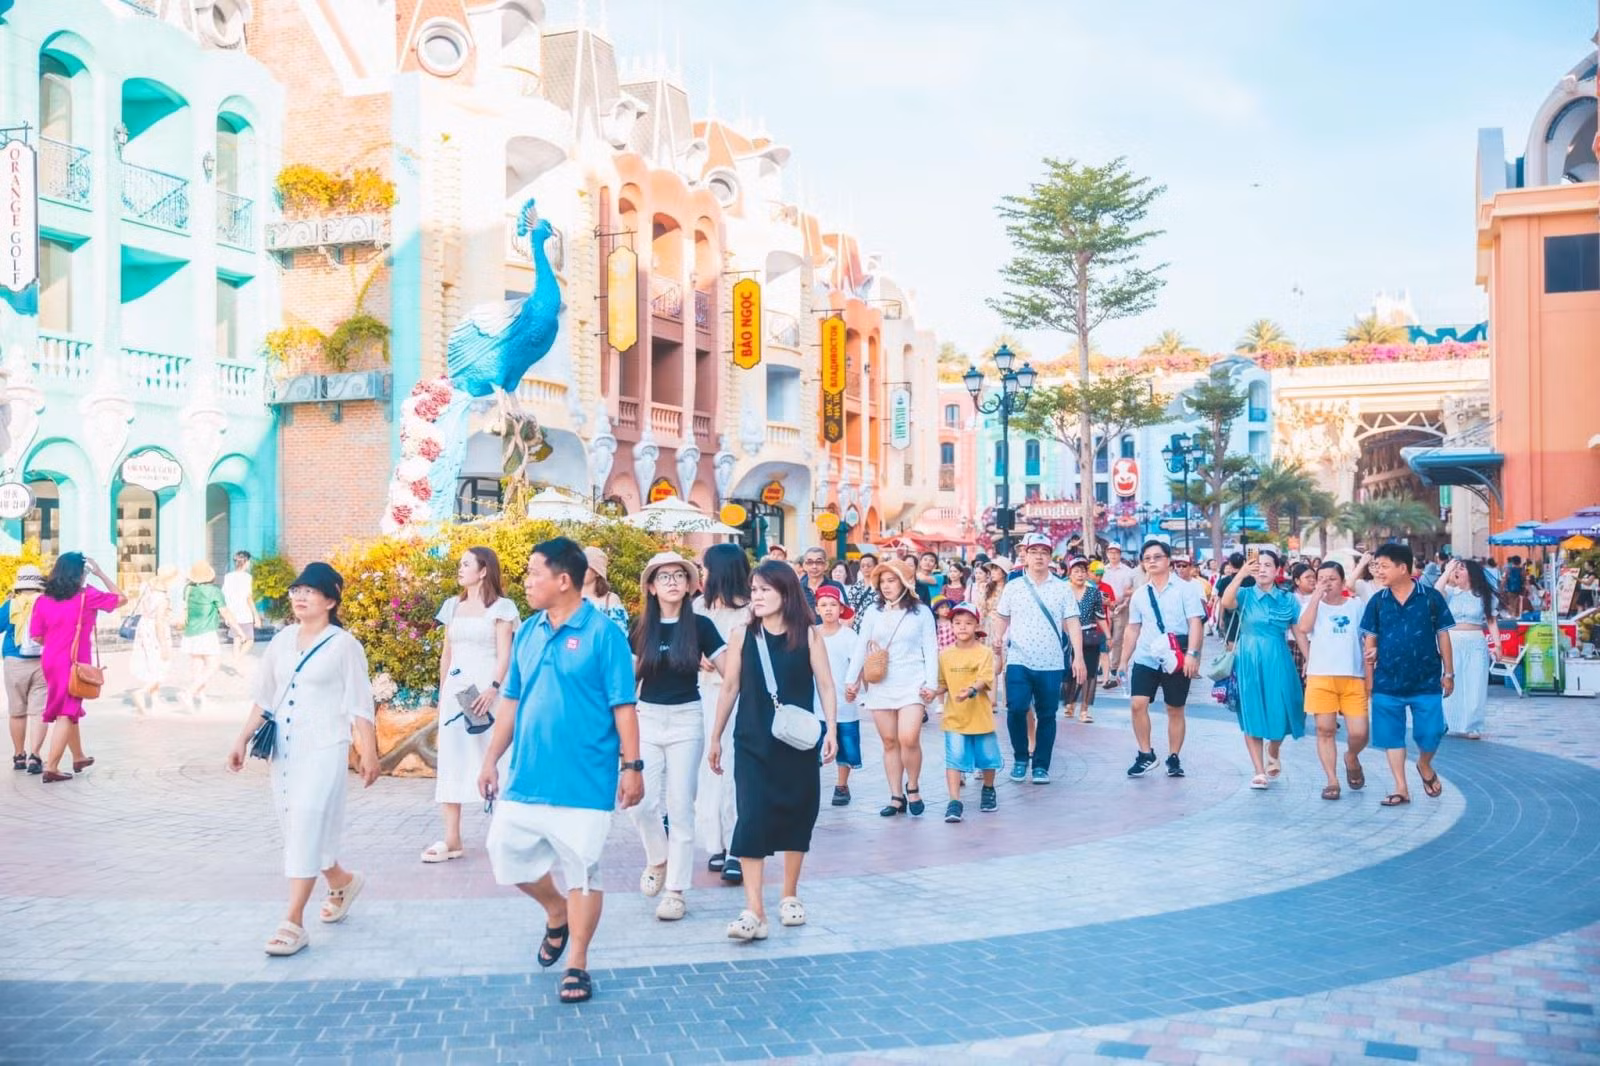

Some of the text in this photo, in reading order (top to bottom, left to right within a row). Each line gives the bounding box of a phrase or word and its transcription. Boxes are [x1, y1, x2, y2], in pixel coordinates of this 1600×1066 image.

[9, 147, 22, 285] ORANGE GOLF
[741, 292, 755, 328] NGỌC
[830, 325, 838, 387] ВЛАДИВОСТОК
[1026, 503, 1081, 518] Langfar
